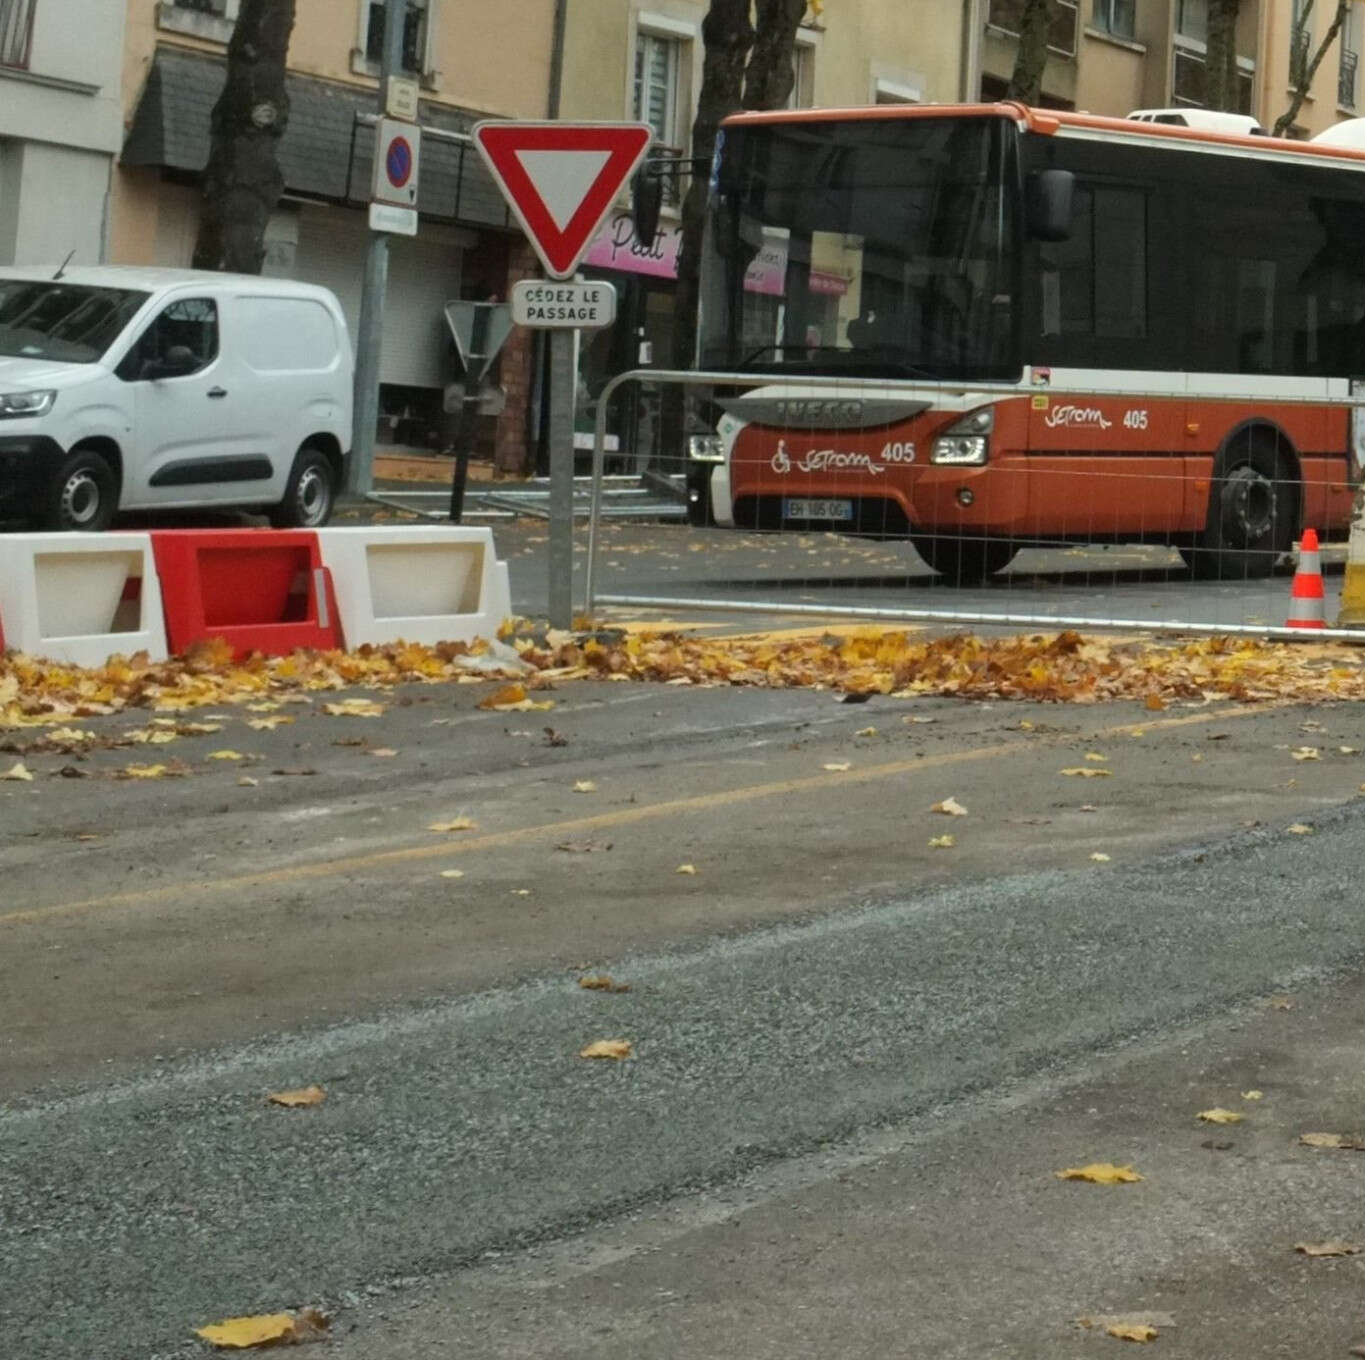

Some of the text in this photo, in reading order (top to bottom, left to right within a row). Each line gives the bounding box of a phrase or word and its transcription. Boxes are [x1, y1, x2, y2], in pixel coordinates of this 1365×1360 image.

[525, 288, 600, 303] CÉDEZ LE
[527, 307, 597, 320] PASSAGE
[1123, 410, 1148, 429] 405
[881, 442, 915, 463] 405
